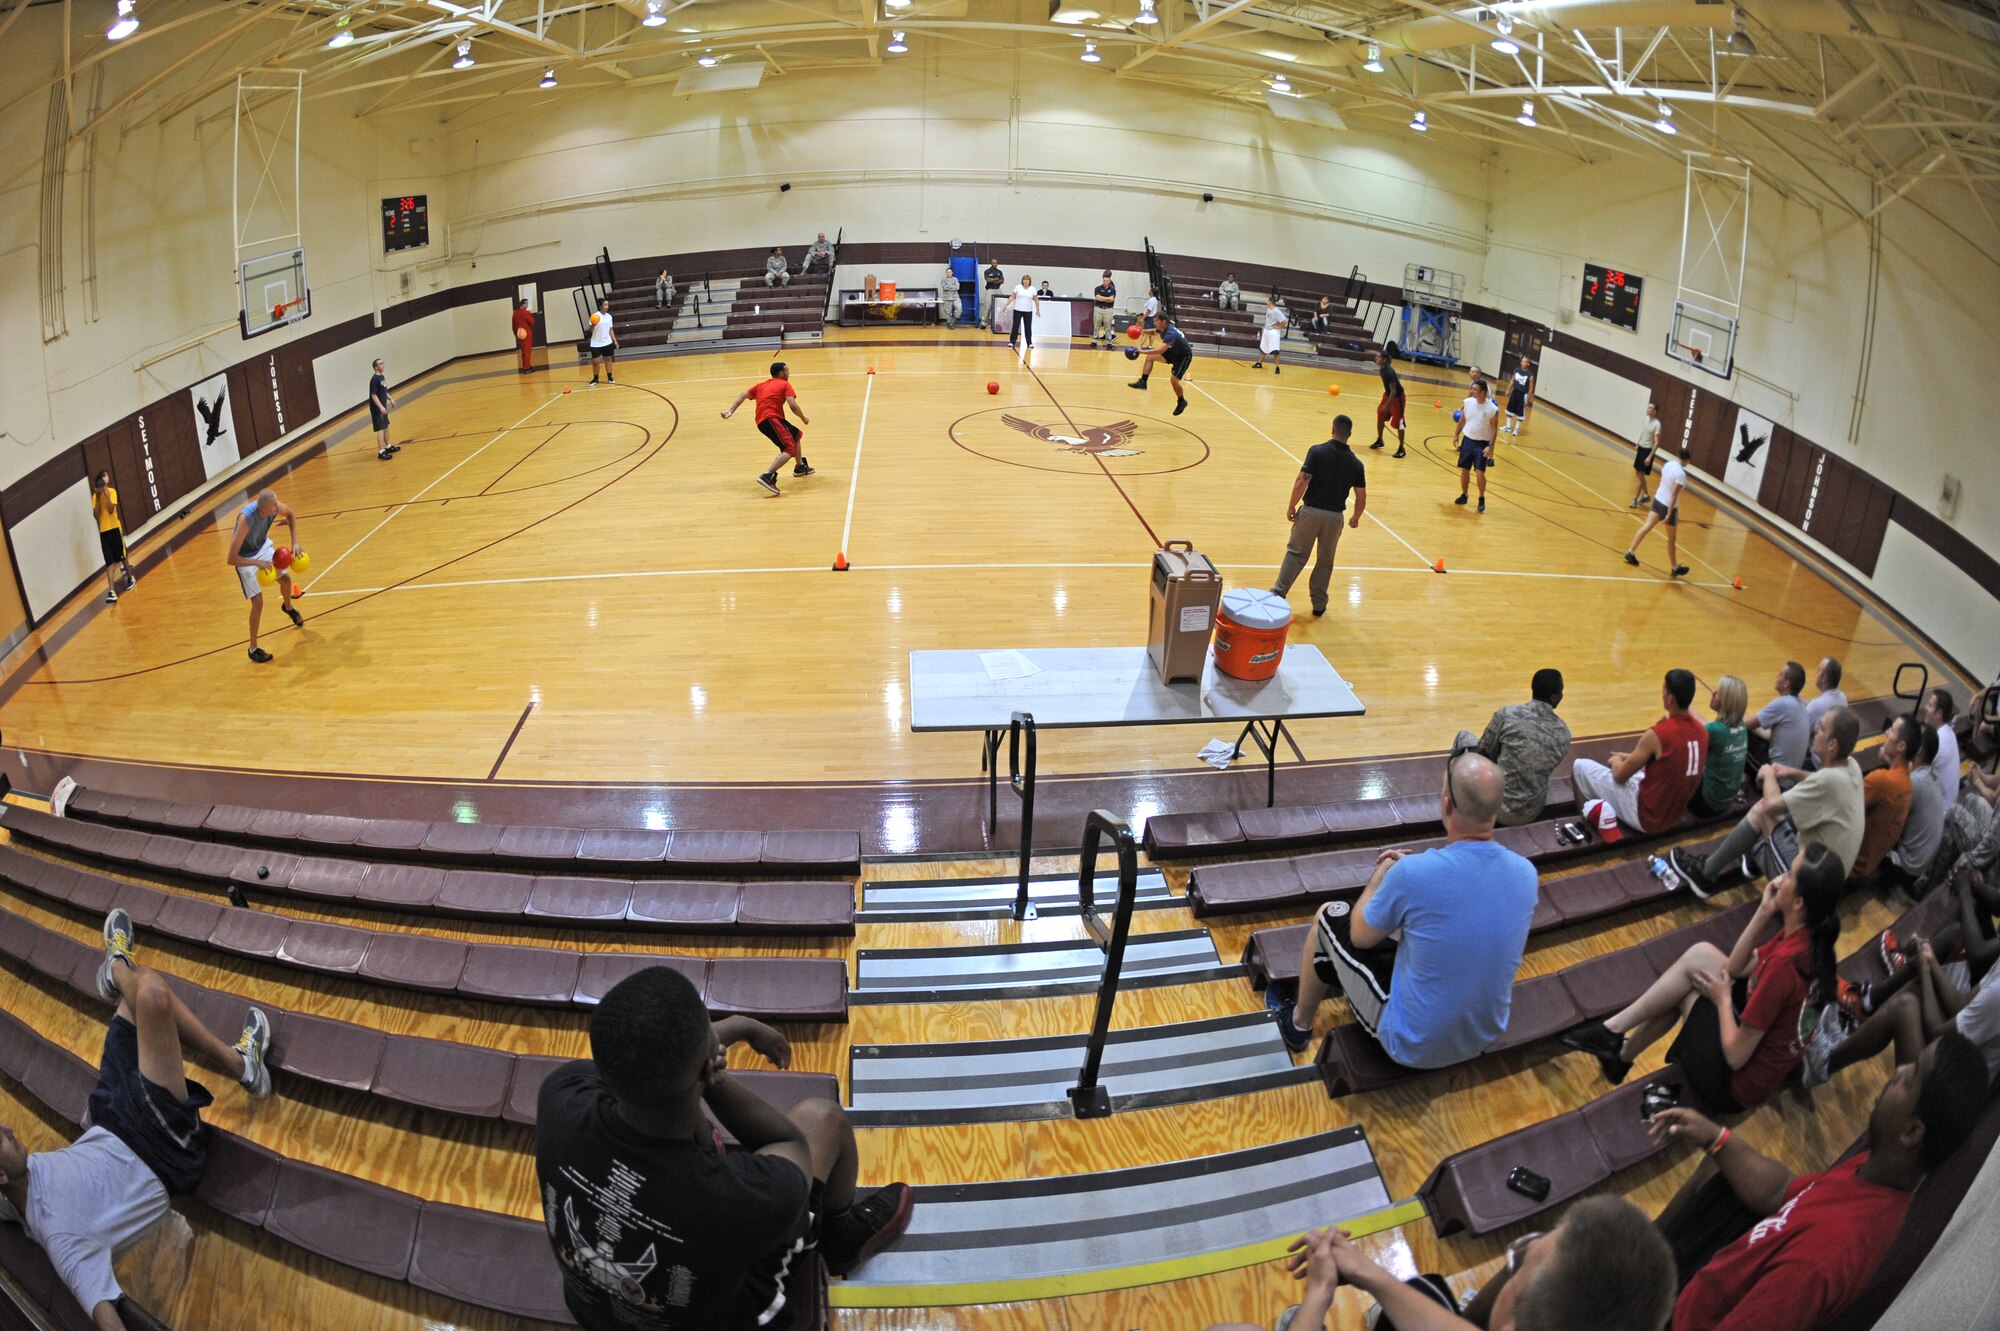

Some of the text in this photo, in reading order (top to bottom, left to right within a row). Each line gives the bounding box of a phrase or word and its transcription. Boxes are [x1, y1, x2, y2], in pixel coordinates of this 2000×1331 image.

[401, 196, 415, 210] 3:26
[1591, 281, 1599, 295] 2
[1606, 268, 1625, 286] 3:26
[269, 354, 286, 435] JOHNSON
[1681, 388, 1697, 449] SEYMOU
[138, 415, 162, 512] SEYMOUR
[1802, 453, 1826, 532] JOHNSON
[1686, 740, 1700, 777] 11
